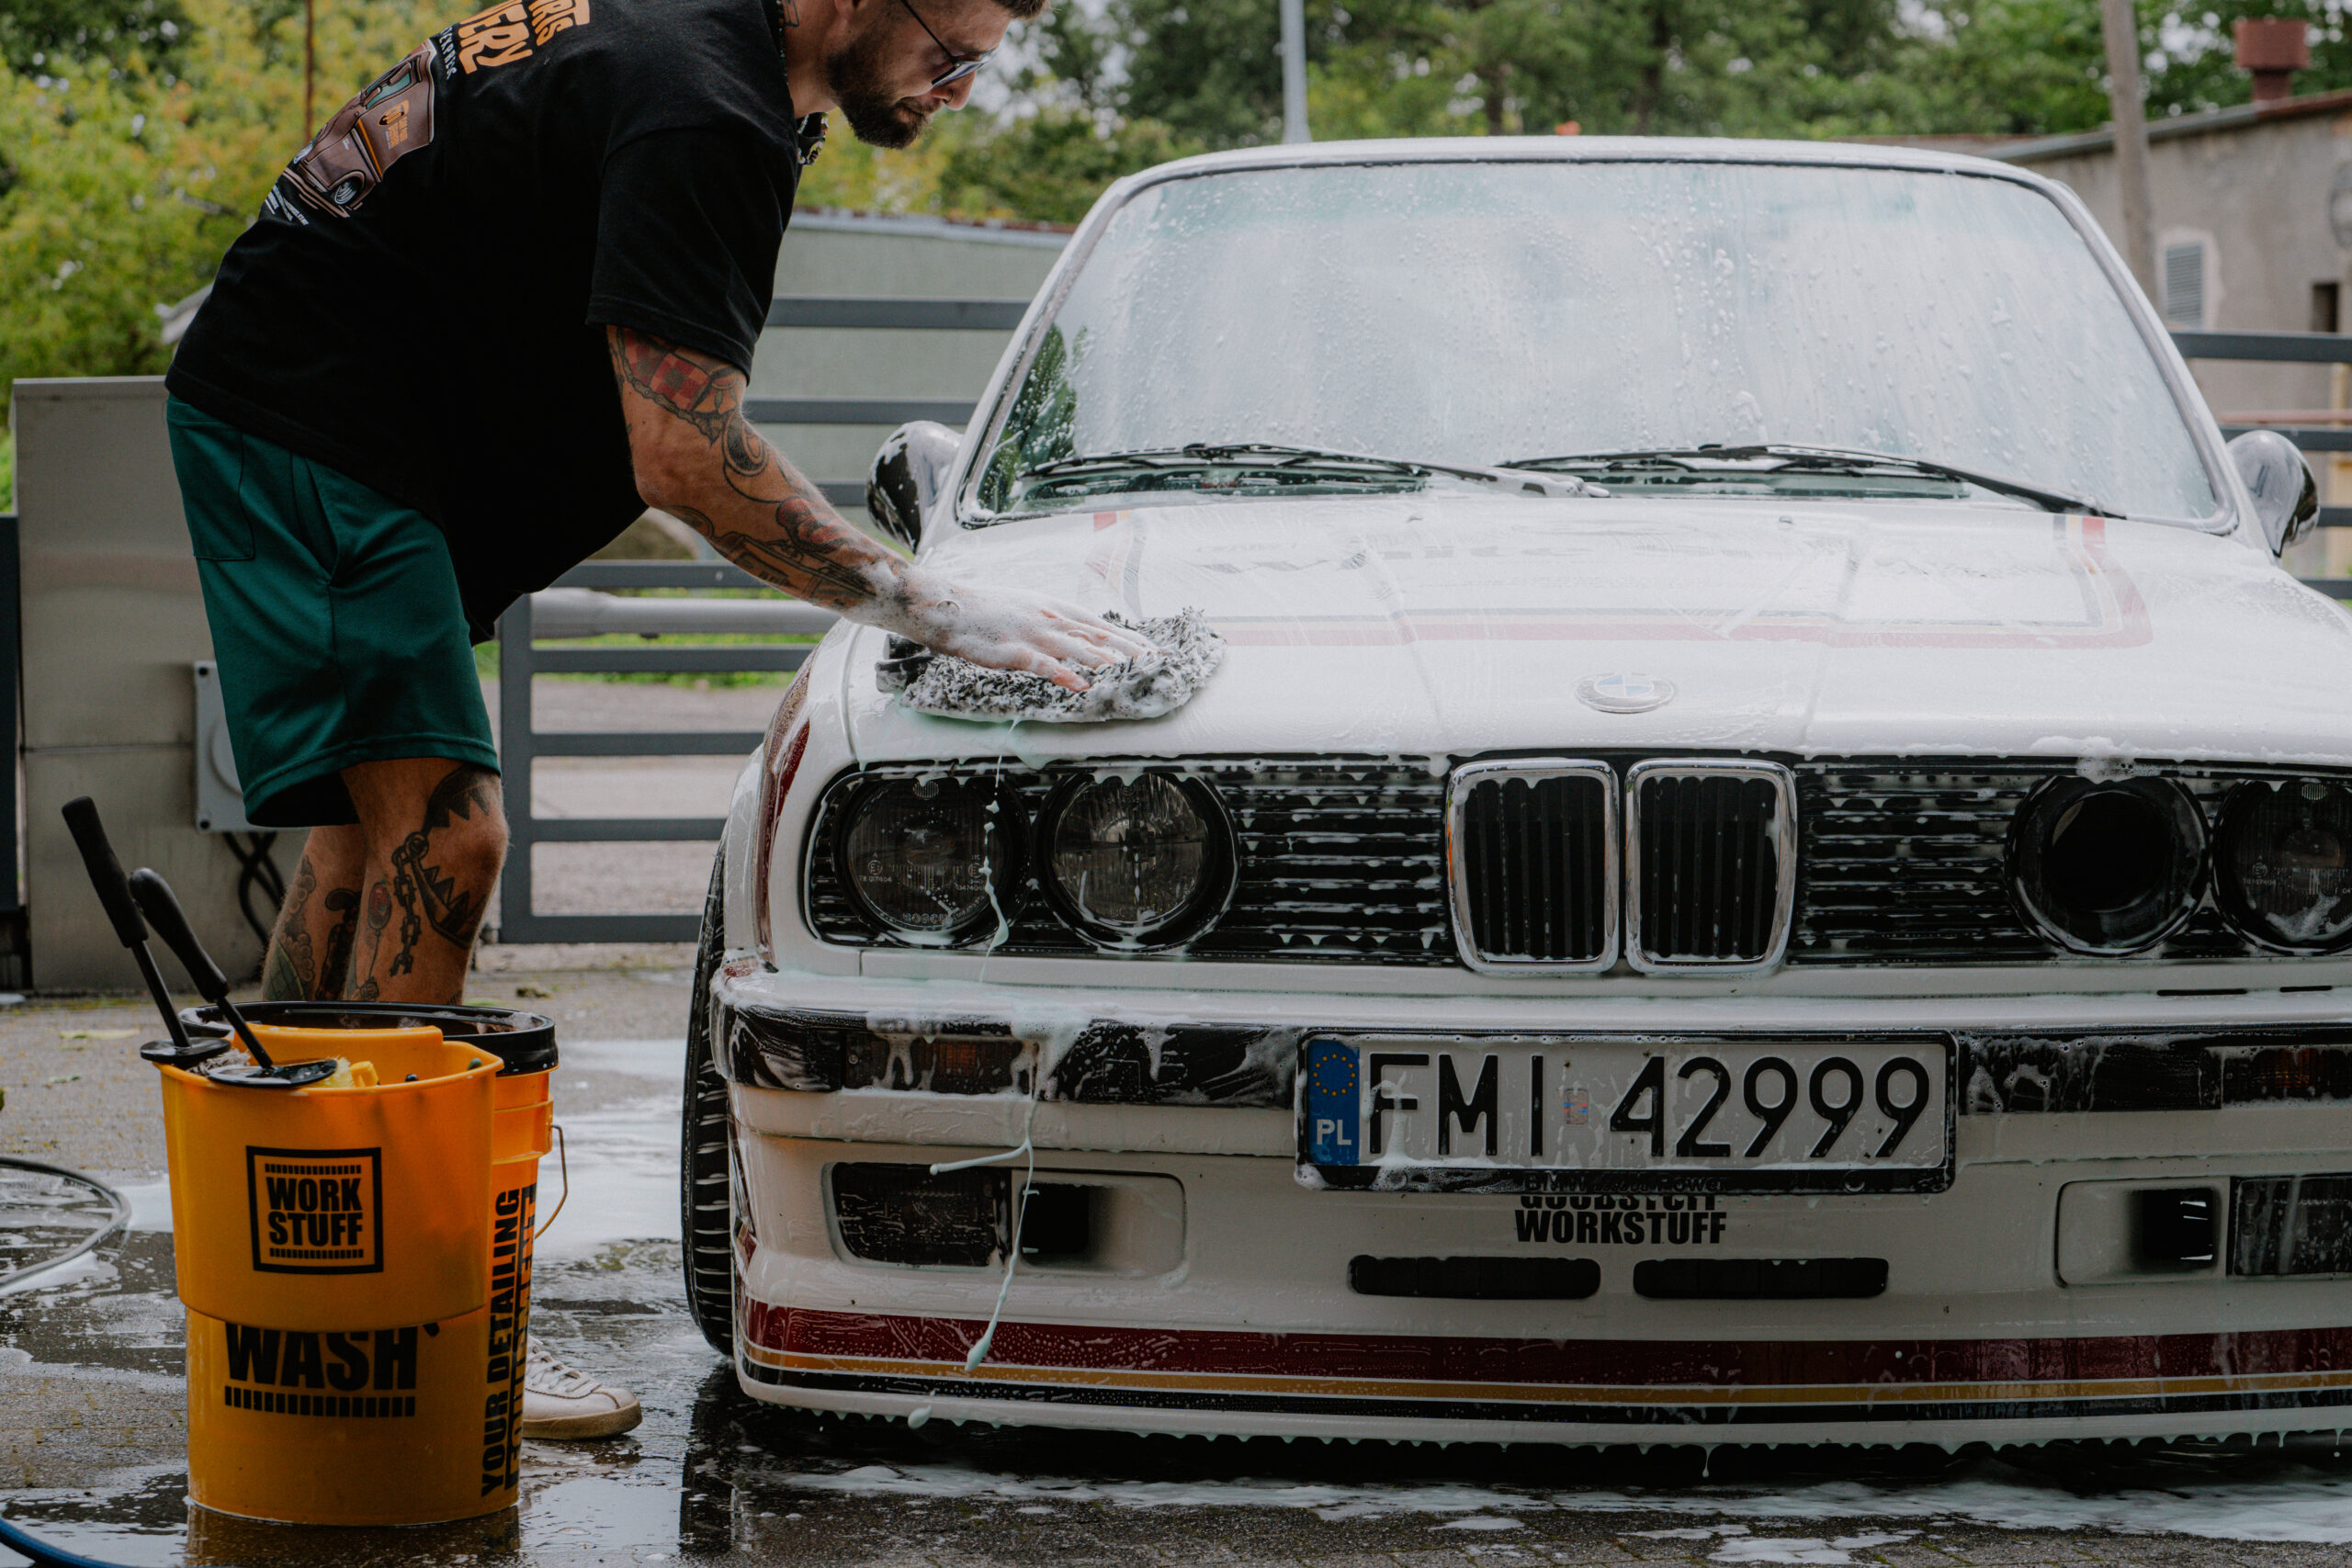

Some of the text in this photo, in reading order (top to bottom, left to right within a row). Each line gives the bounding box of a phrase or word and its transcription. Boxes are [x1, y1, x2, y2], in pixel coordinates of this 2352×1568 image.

[1369, 1053, 1930, 1158] FMI 42999
[1316, 1118, 1352, 1146] PL
[266, 1176, 363, 1212] WORK
[269, 1212, 364, 1247] STUFF
[1515, 1210, 1727, 1245] WORKSTUFF
[226, 1324, 416, 1392] WASH
[481, 1190, 520, 1496] YOUR DETAILING
